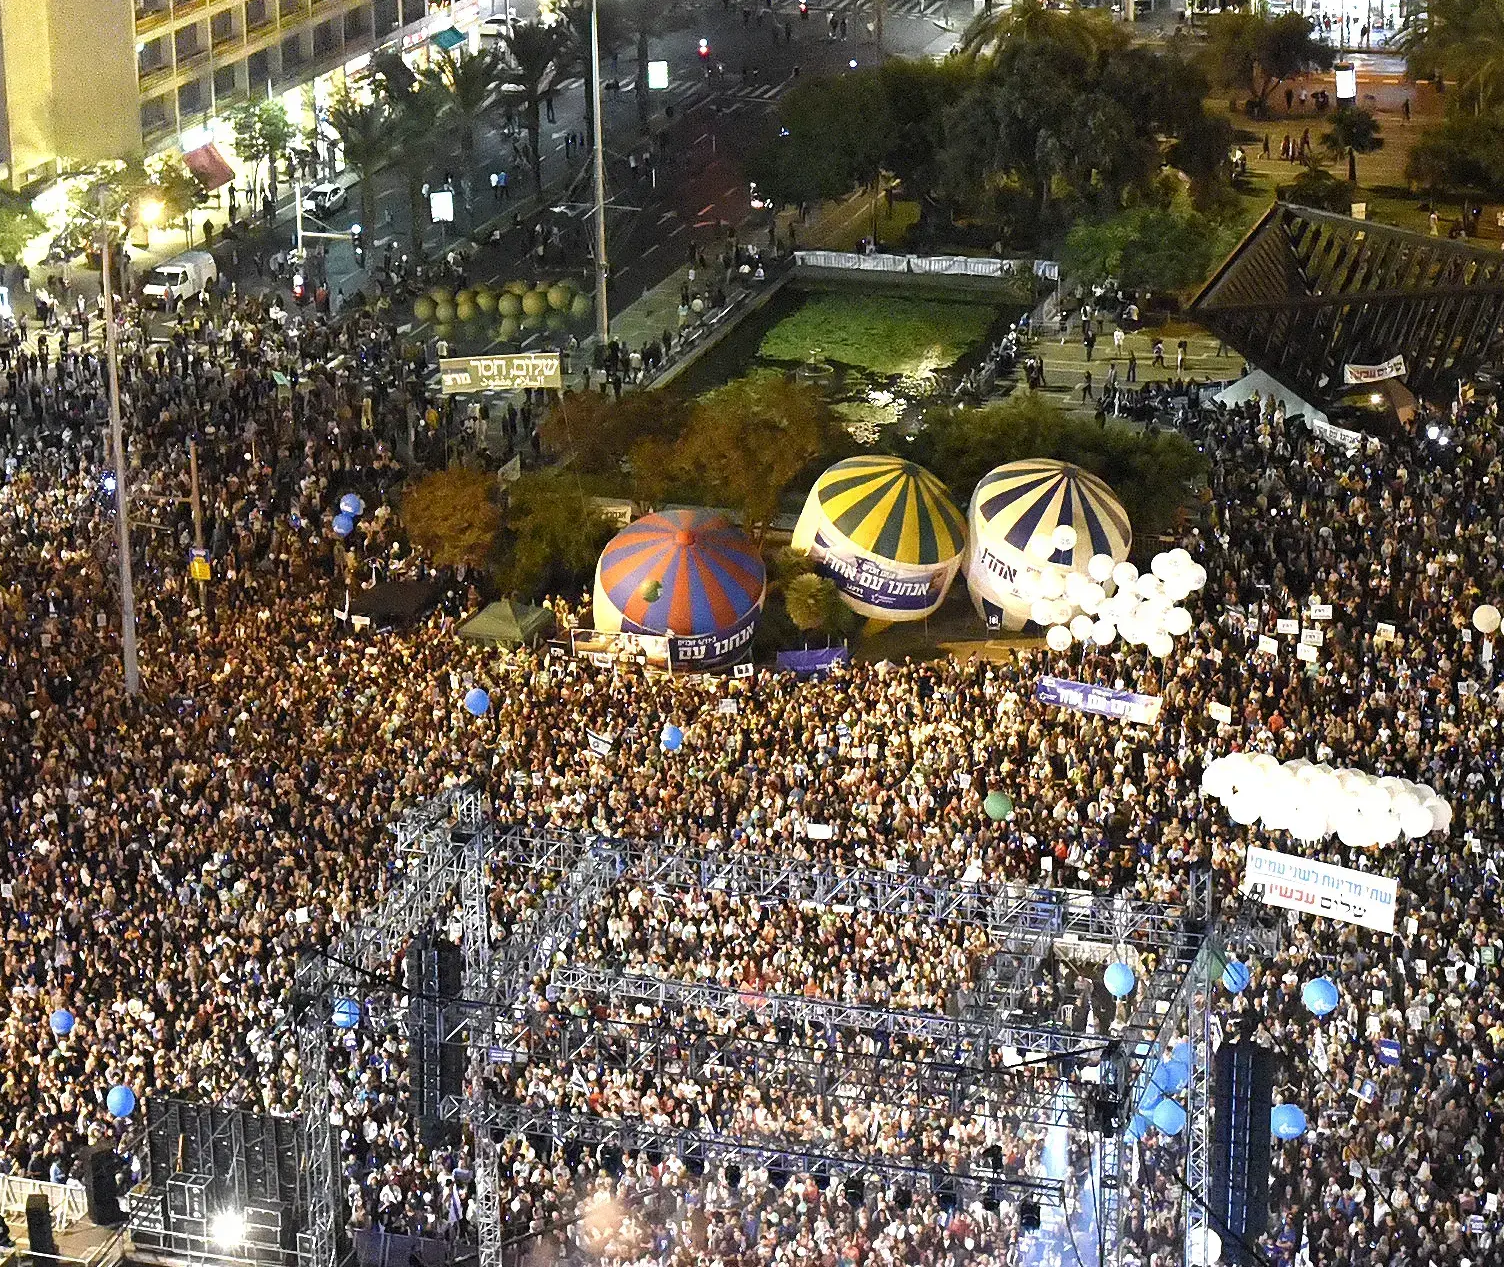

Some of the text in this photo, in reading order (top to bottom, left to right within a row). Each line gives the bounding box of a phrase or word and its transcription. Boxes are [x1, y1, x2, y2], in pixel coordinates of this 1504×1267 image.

[469, 359, 507, 377] חסר
[981, 548, 1018, 583] אחד!
[858, 572, 884, 591] עם
[887, 579, 930, 596] אנחנו
[678, 621, 755, 661] אנחנו עם
[1289, 865, 1319, 884] לשני
[1322, 875, 1362, 897] מדינות
[1269, 883, 1367, 918] שלום עכשיו
[1365, 887, 1392, 905] שתי
